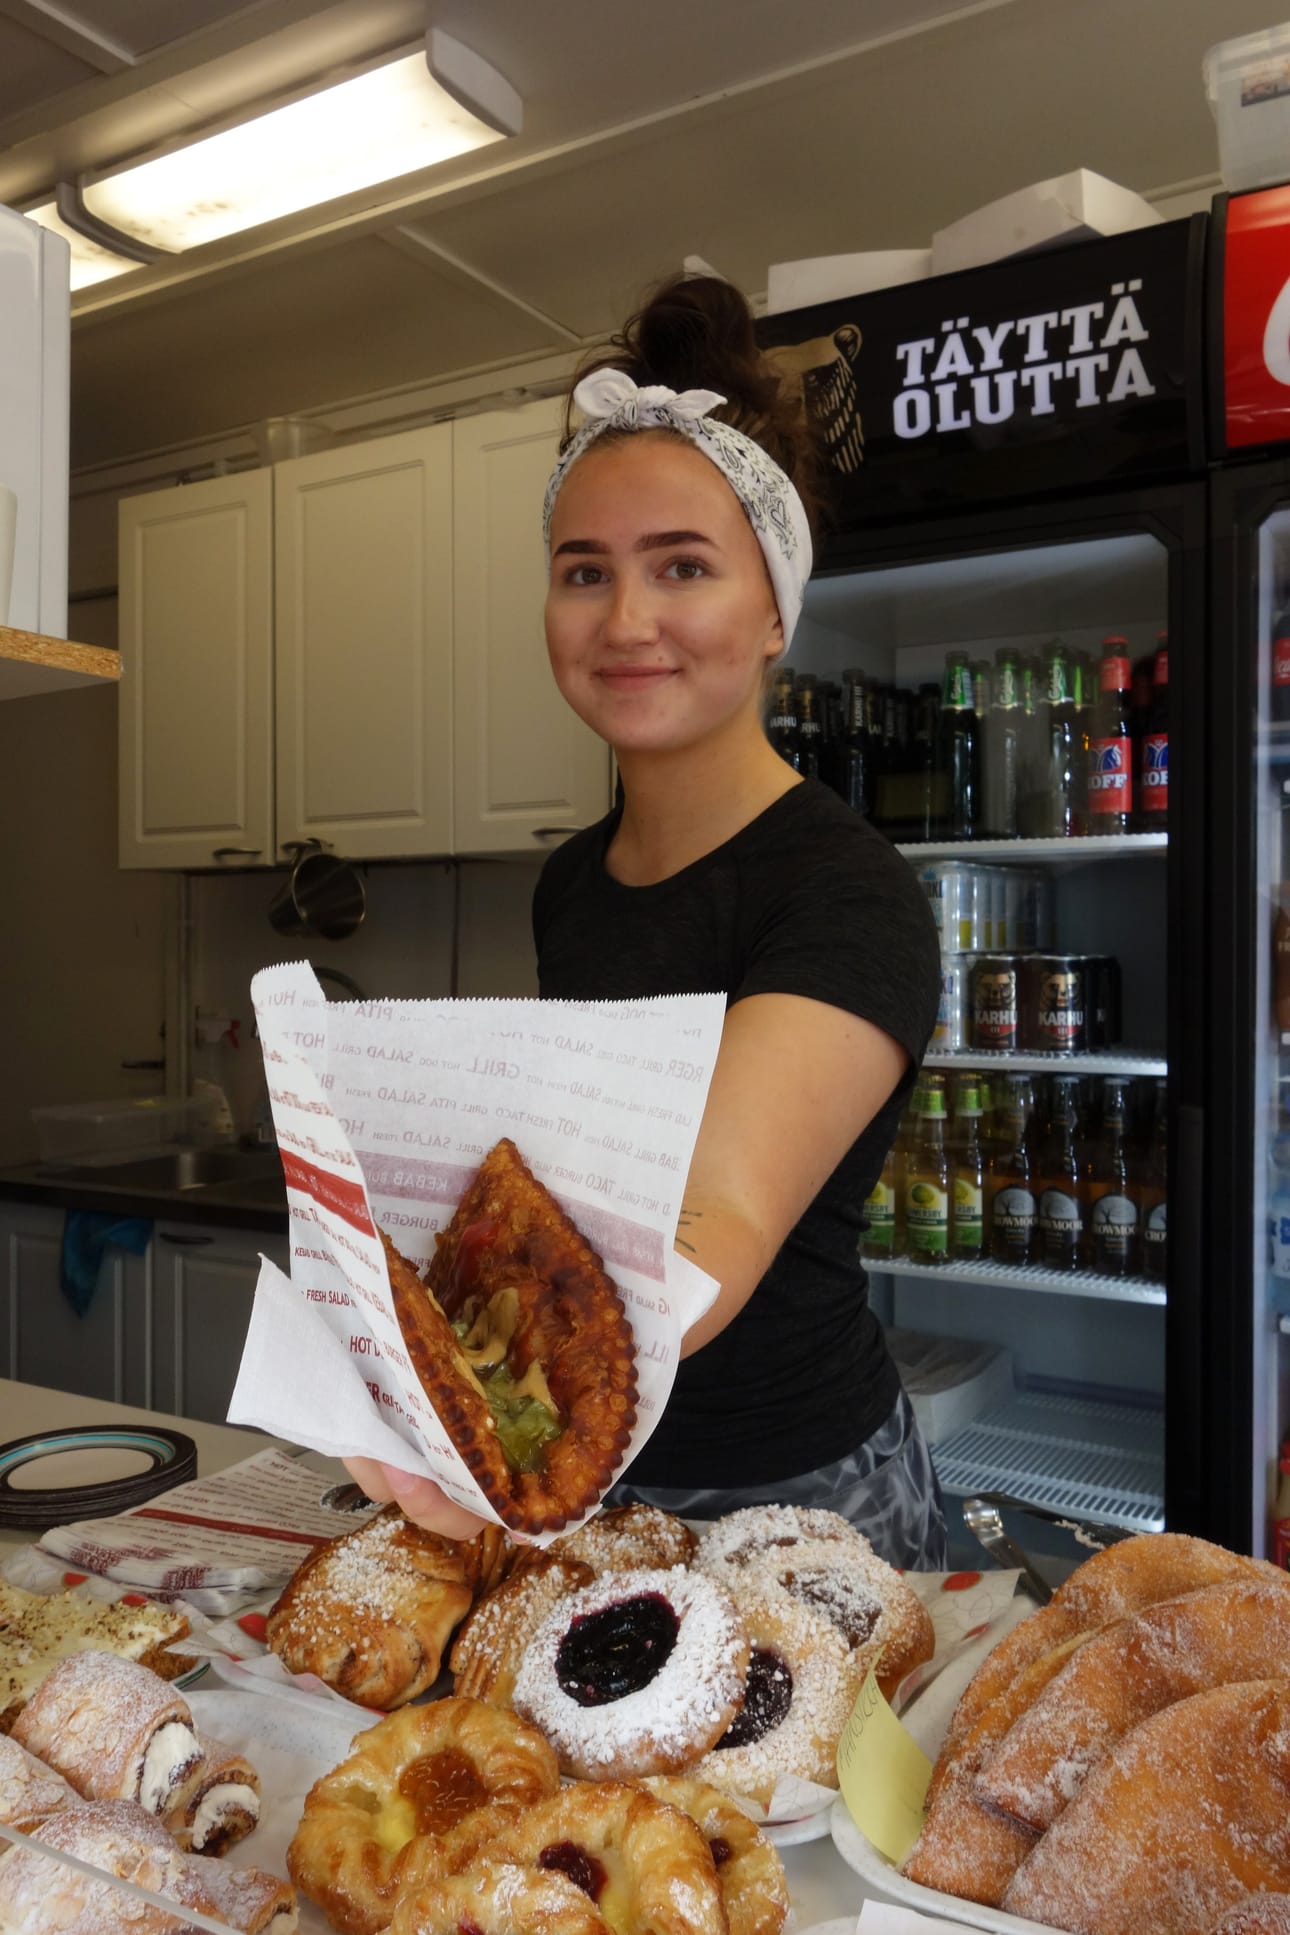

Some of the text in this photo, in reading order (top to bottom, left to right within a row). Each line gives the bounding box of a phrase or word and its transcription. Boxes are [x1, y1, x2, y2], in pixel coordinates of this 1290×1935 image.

[896, 279, 1149, 387] TÄYTTÄ
[893, 347, 1156, 440] OLUTTA
[1039, 1010, 1084, 1026] KARHU
[306, 1288, 327, 1303] FRESH
[328, 1290, 350, 1307] SALAD
[349, 1334, 372, 1355] HOT
